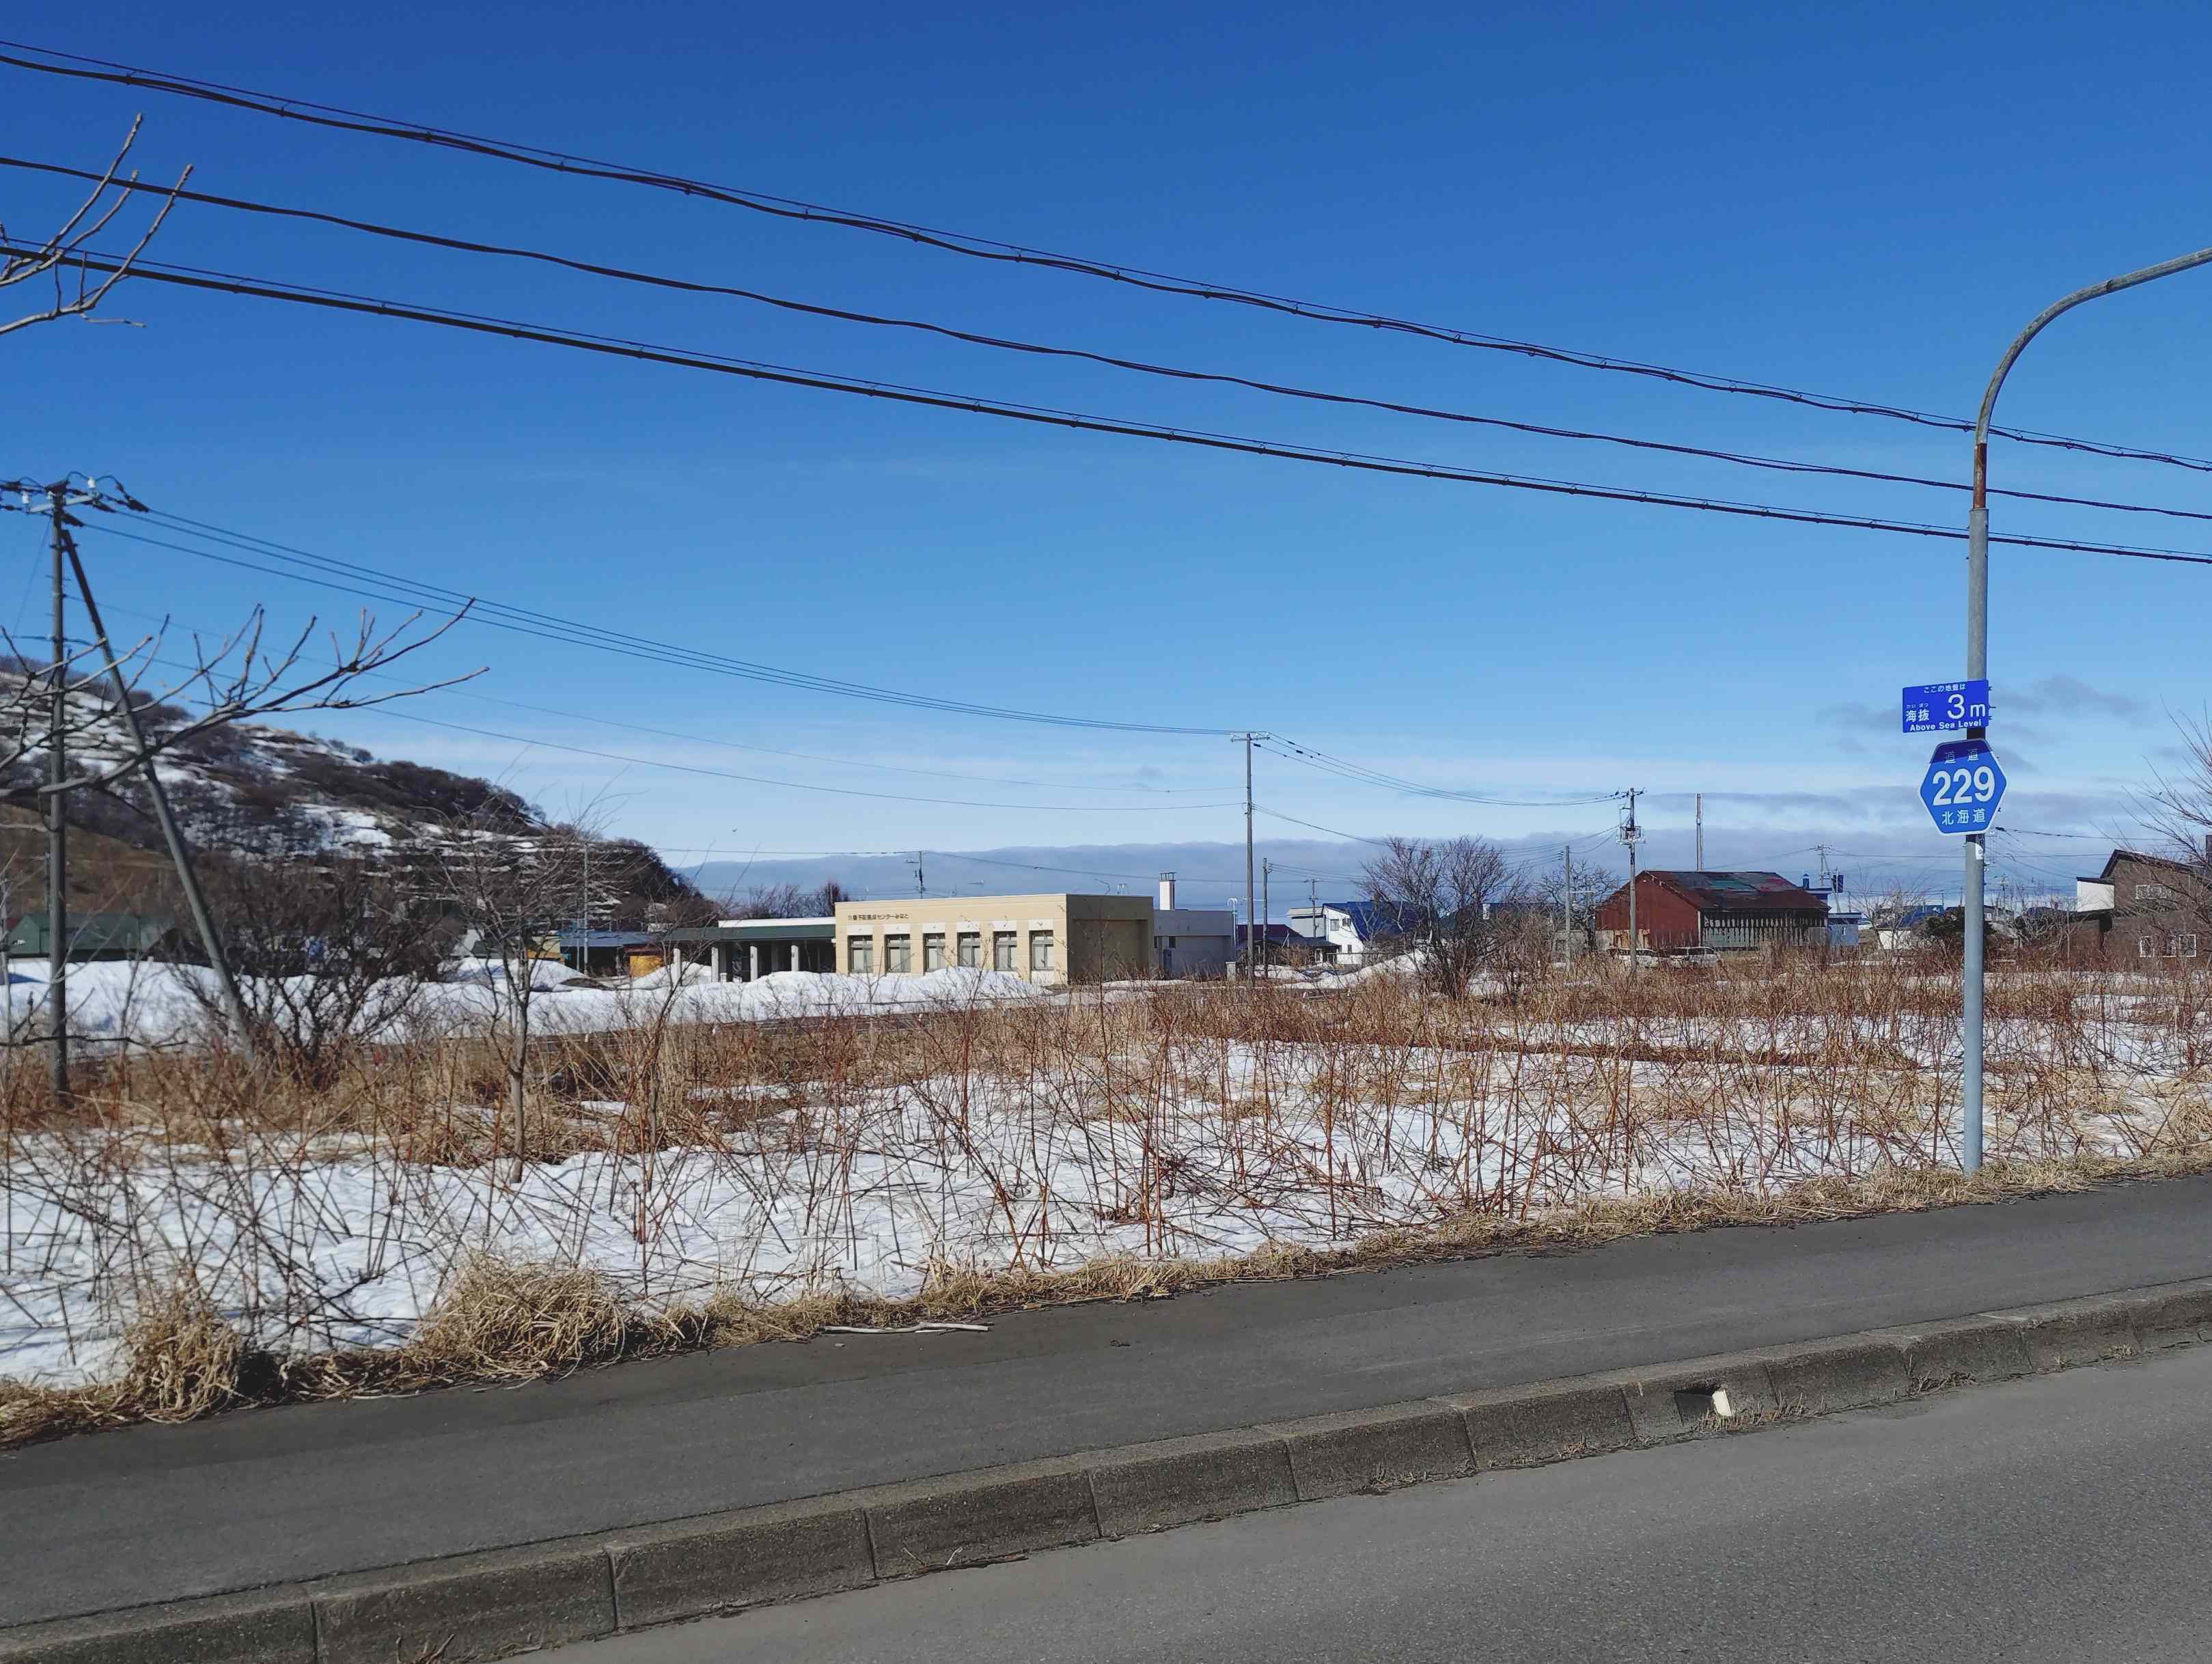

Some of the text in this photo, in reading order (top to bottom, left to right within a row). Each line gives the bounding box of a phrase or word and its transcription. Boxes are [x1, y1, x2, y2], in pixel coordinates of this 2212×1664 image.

[1906, 709, 1930, 722] 海抜
[1939, 721, 1955, 730] Sea
[1958, 719, 1981, 728] Level
[1933, 766, 1995, 806] 229
[1941, 808, 1987, 825] 北海道
